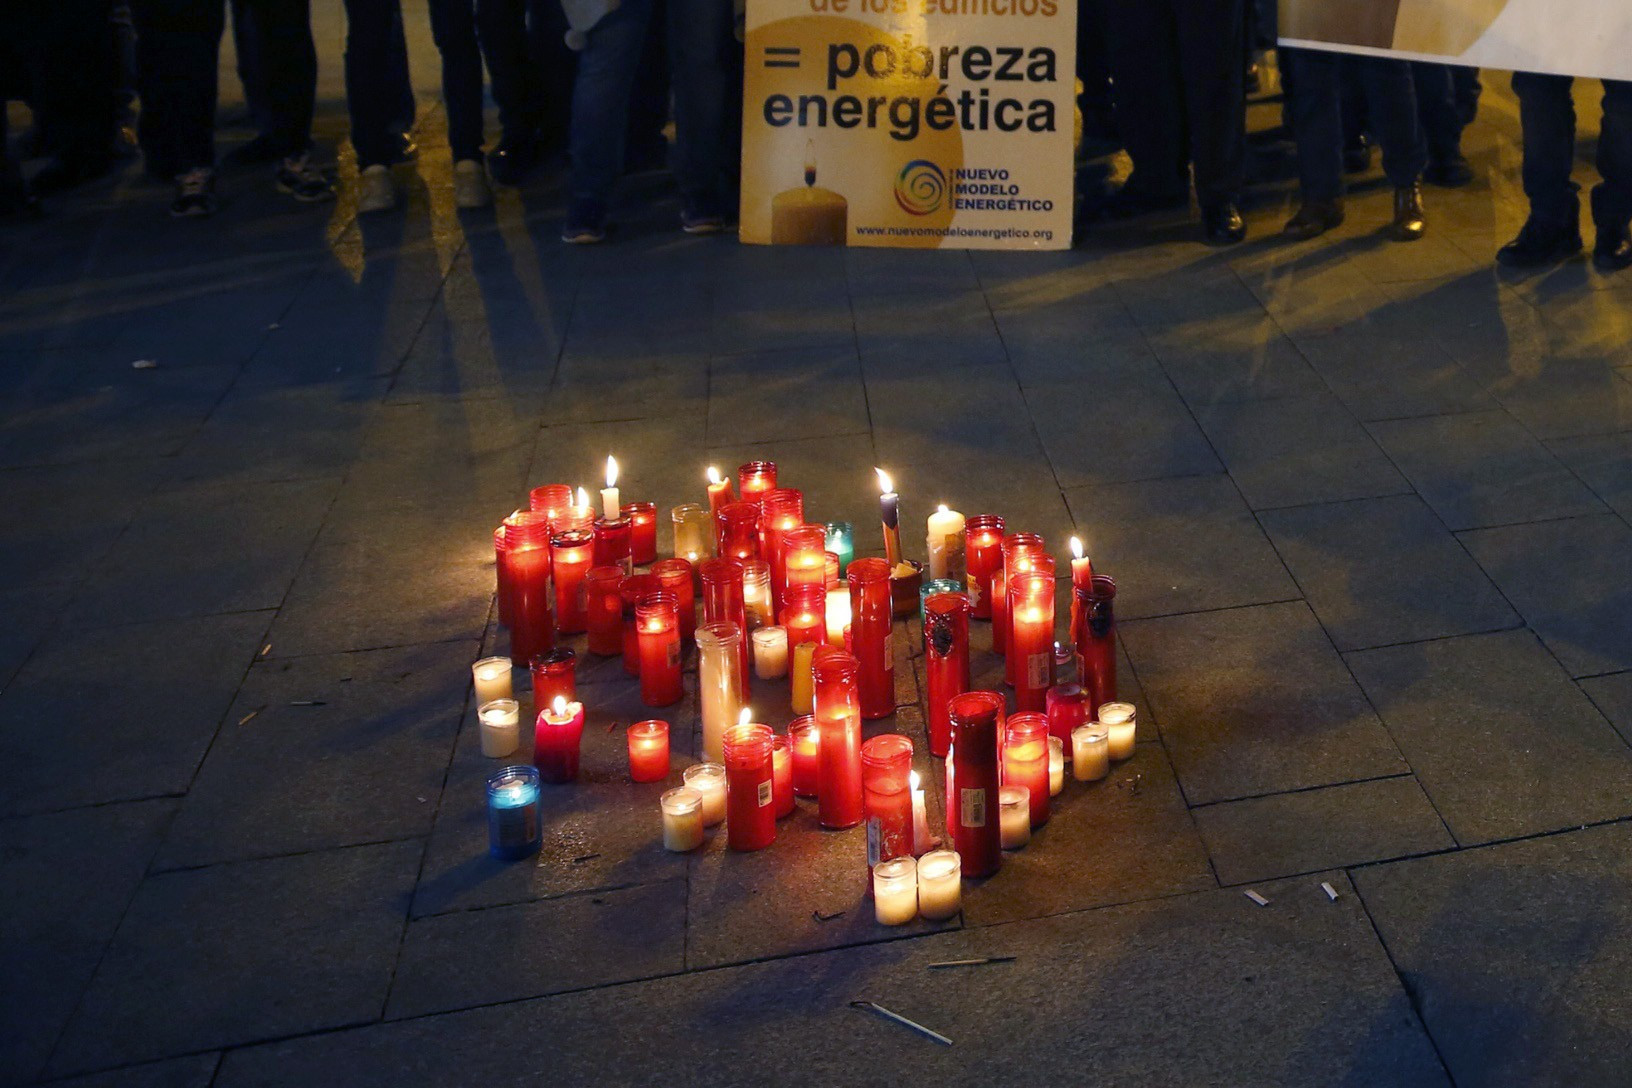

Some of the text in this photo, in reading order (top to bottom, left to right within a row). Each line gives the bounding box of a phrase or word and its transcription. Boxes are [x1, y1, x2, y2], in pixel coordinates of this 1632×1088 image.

[763, 34, 1058, 90] = pobreza
[762, 84, 1057, 142] energética
[955, 169, 1009, 181] NUEVO
[955, 184, 1019, 196] MODELO
[955, 197, 1053, 212] ENERGÉTICO
[855, 226, 1053, 241] www.nuevomodeloenergetico.org
